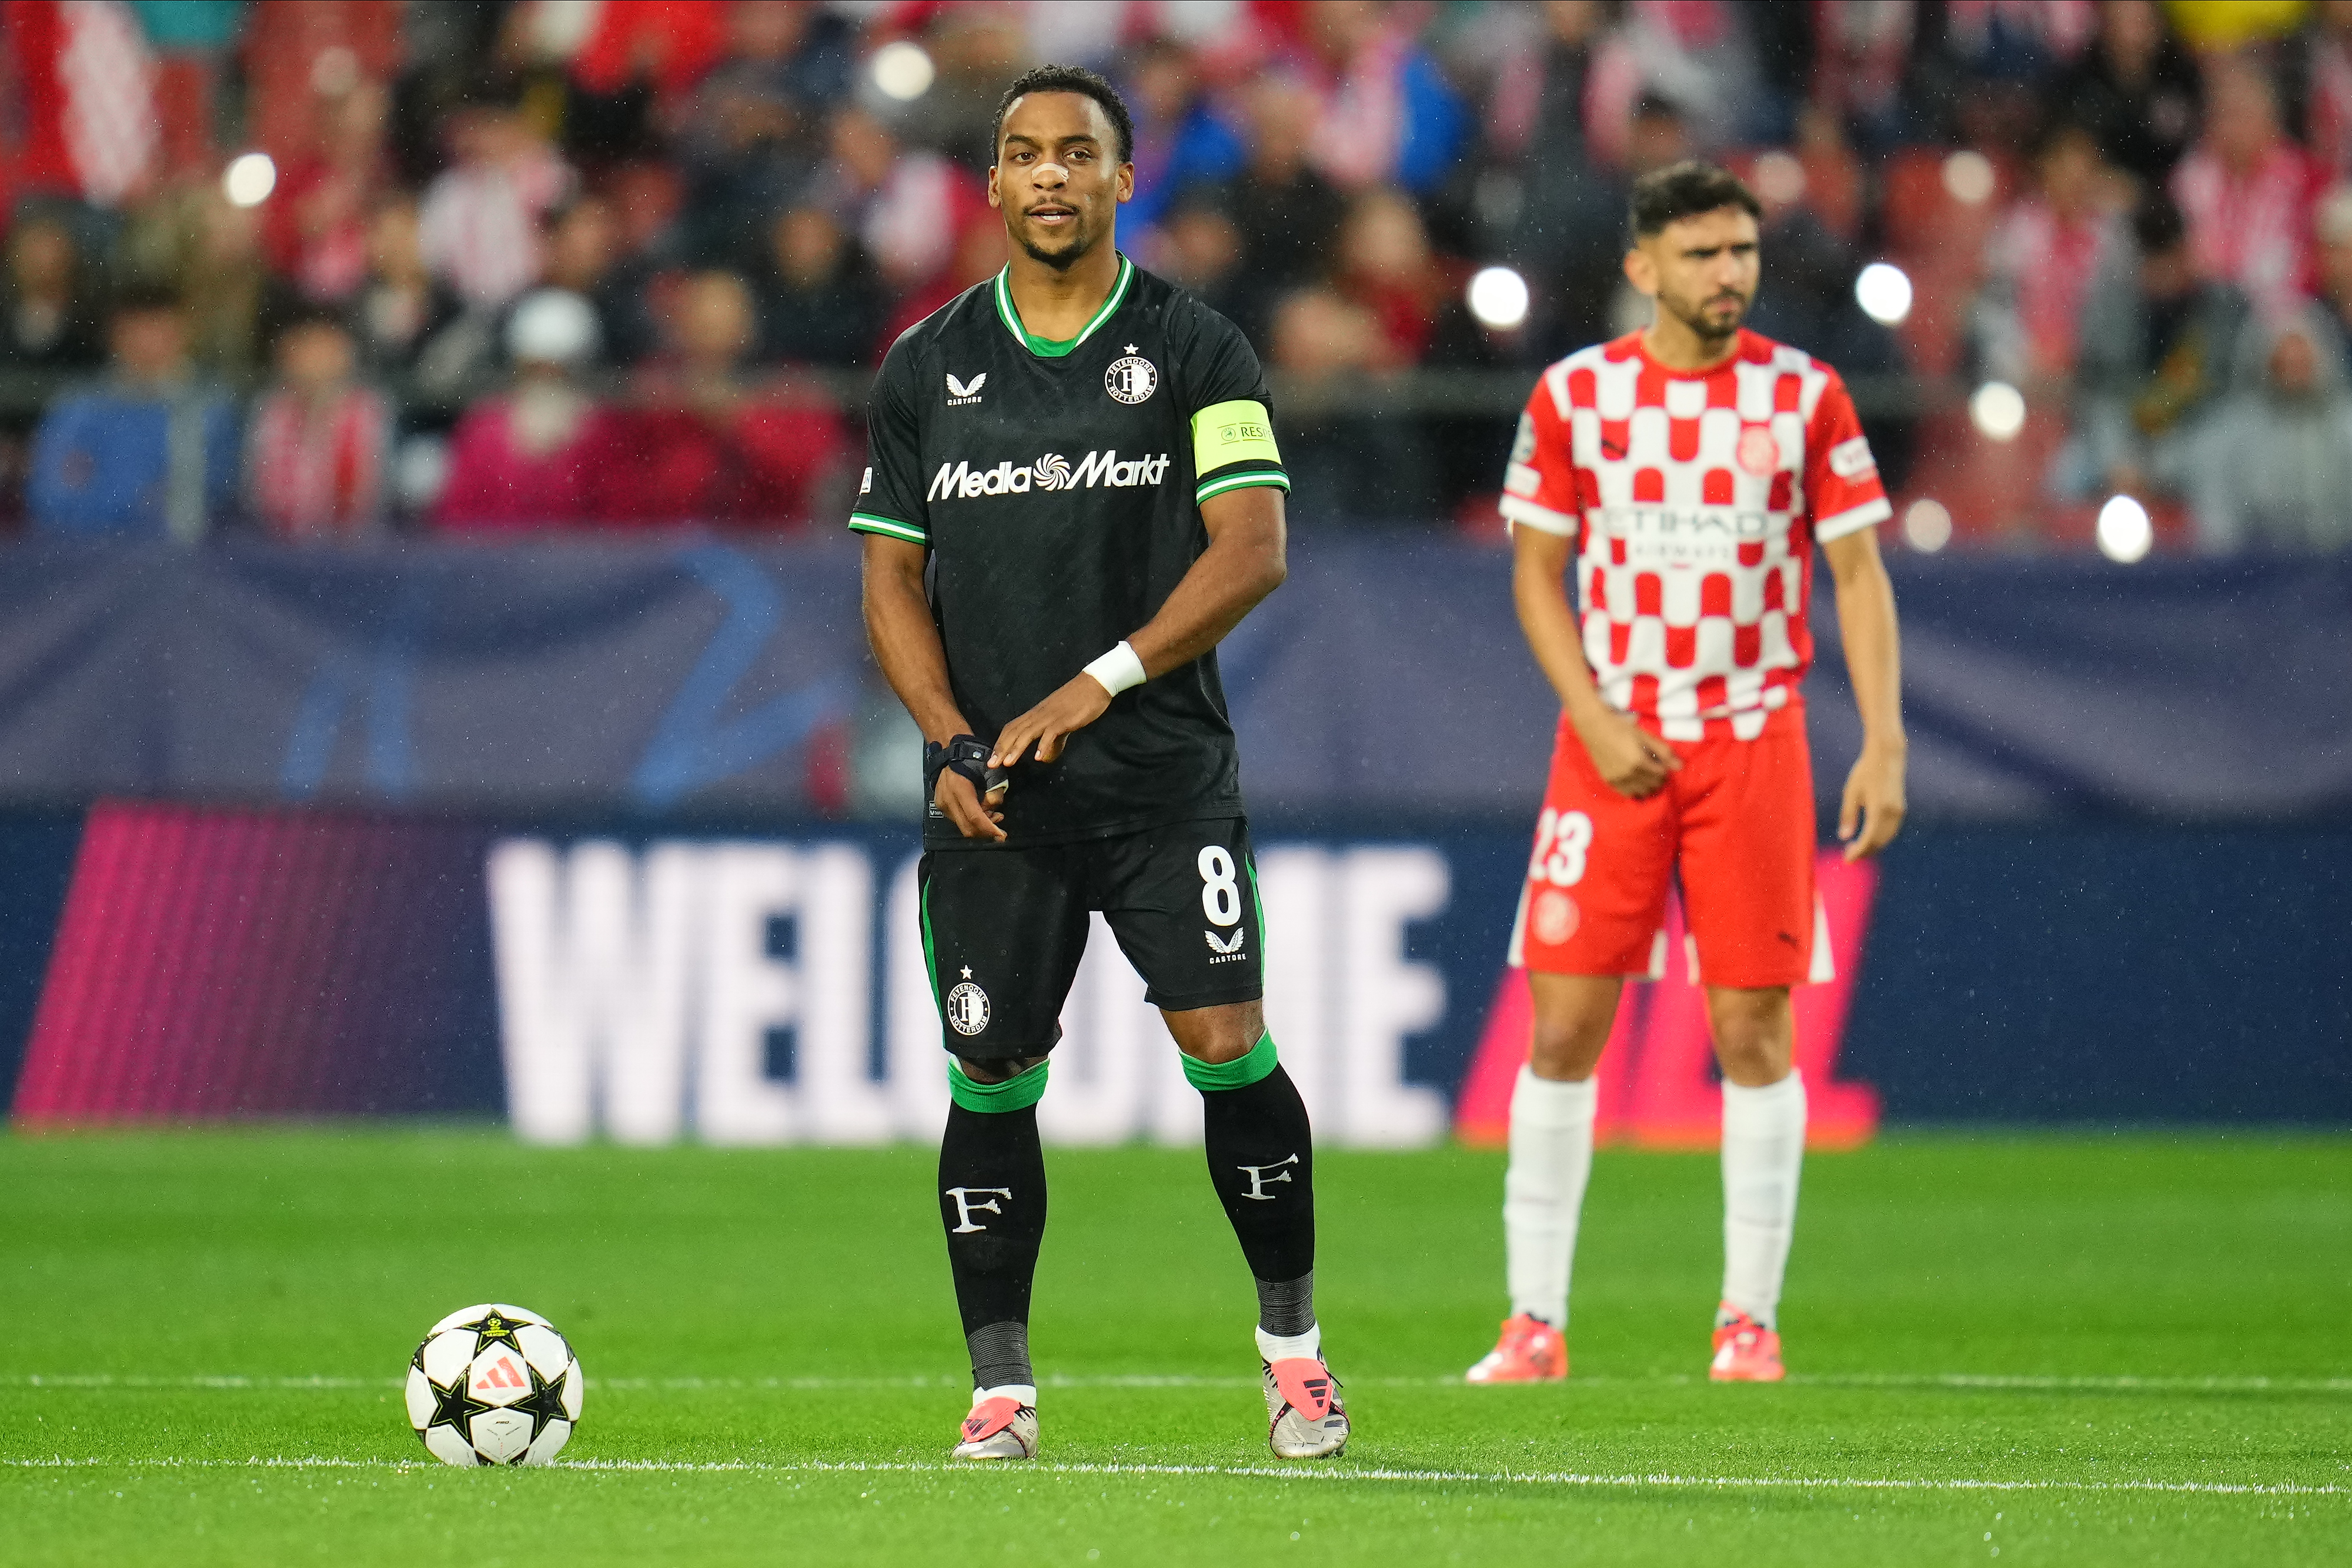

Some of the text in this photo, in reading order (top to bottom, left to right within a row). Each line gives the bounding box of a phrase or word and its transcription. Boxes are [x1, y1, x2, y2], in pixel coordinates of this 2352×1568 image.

[1109, 359, 1153, 375] FEYENOORD
[1120, 369, 1141, 392] F
[947, 396, 982, 406] CASTORE
[1109, 385, 1154, 402] ROTTERDAM
[1241, 426, 1275, 441] RESPE
[1064, 450, 1170, 490] Markt
[1528, 806, 1593, 887] 23
[1198, 845, 1241, 926] 8
[1210, 953, 1247, 965] CASTORE
[950, 984, 986, 1002] FEYENOORD
[959, 996, 976, 1022] F
[951, 1015, 987, 1033] ROTTERDAM
[1237, 1153, 1299, 1200] F
[946, 1187, 1013, 1233] F
